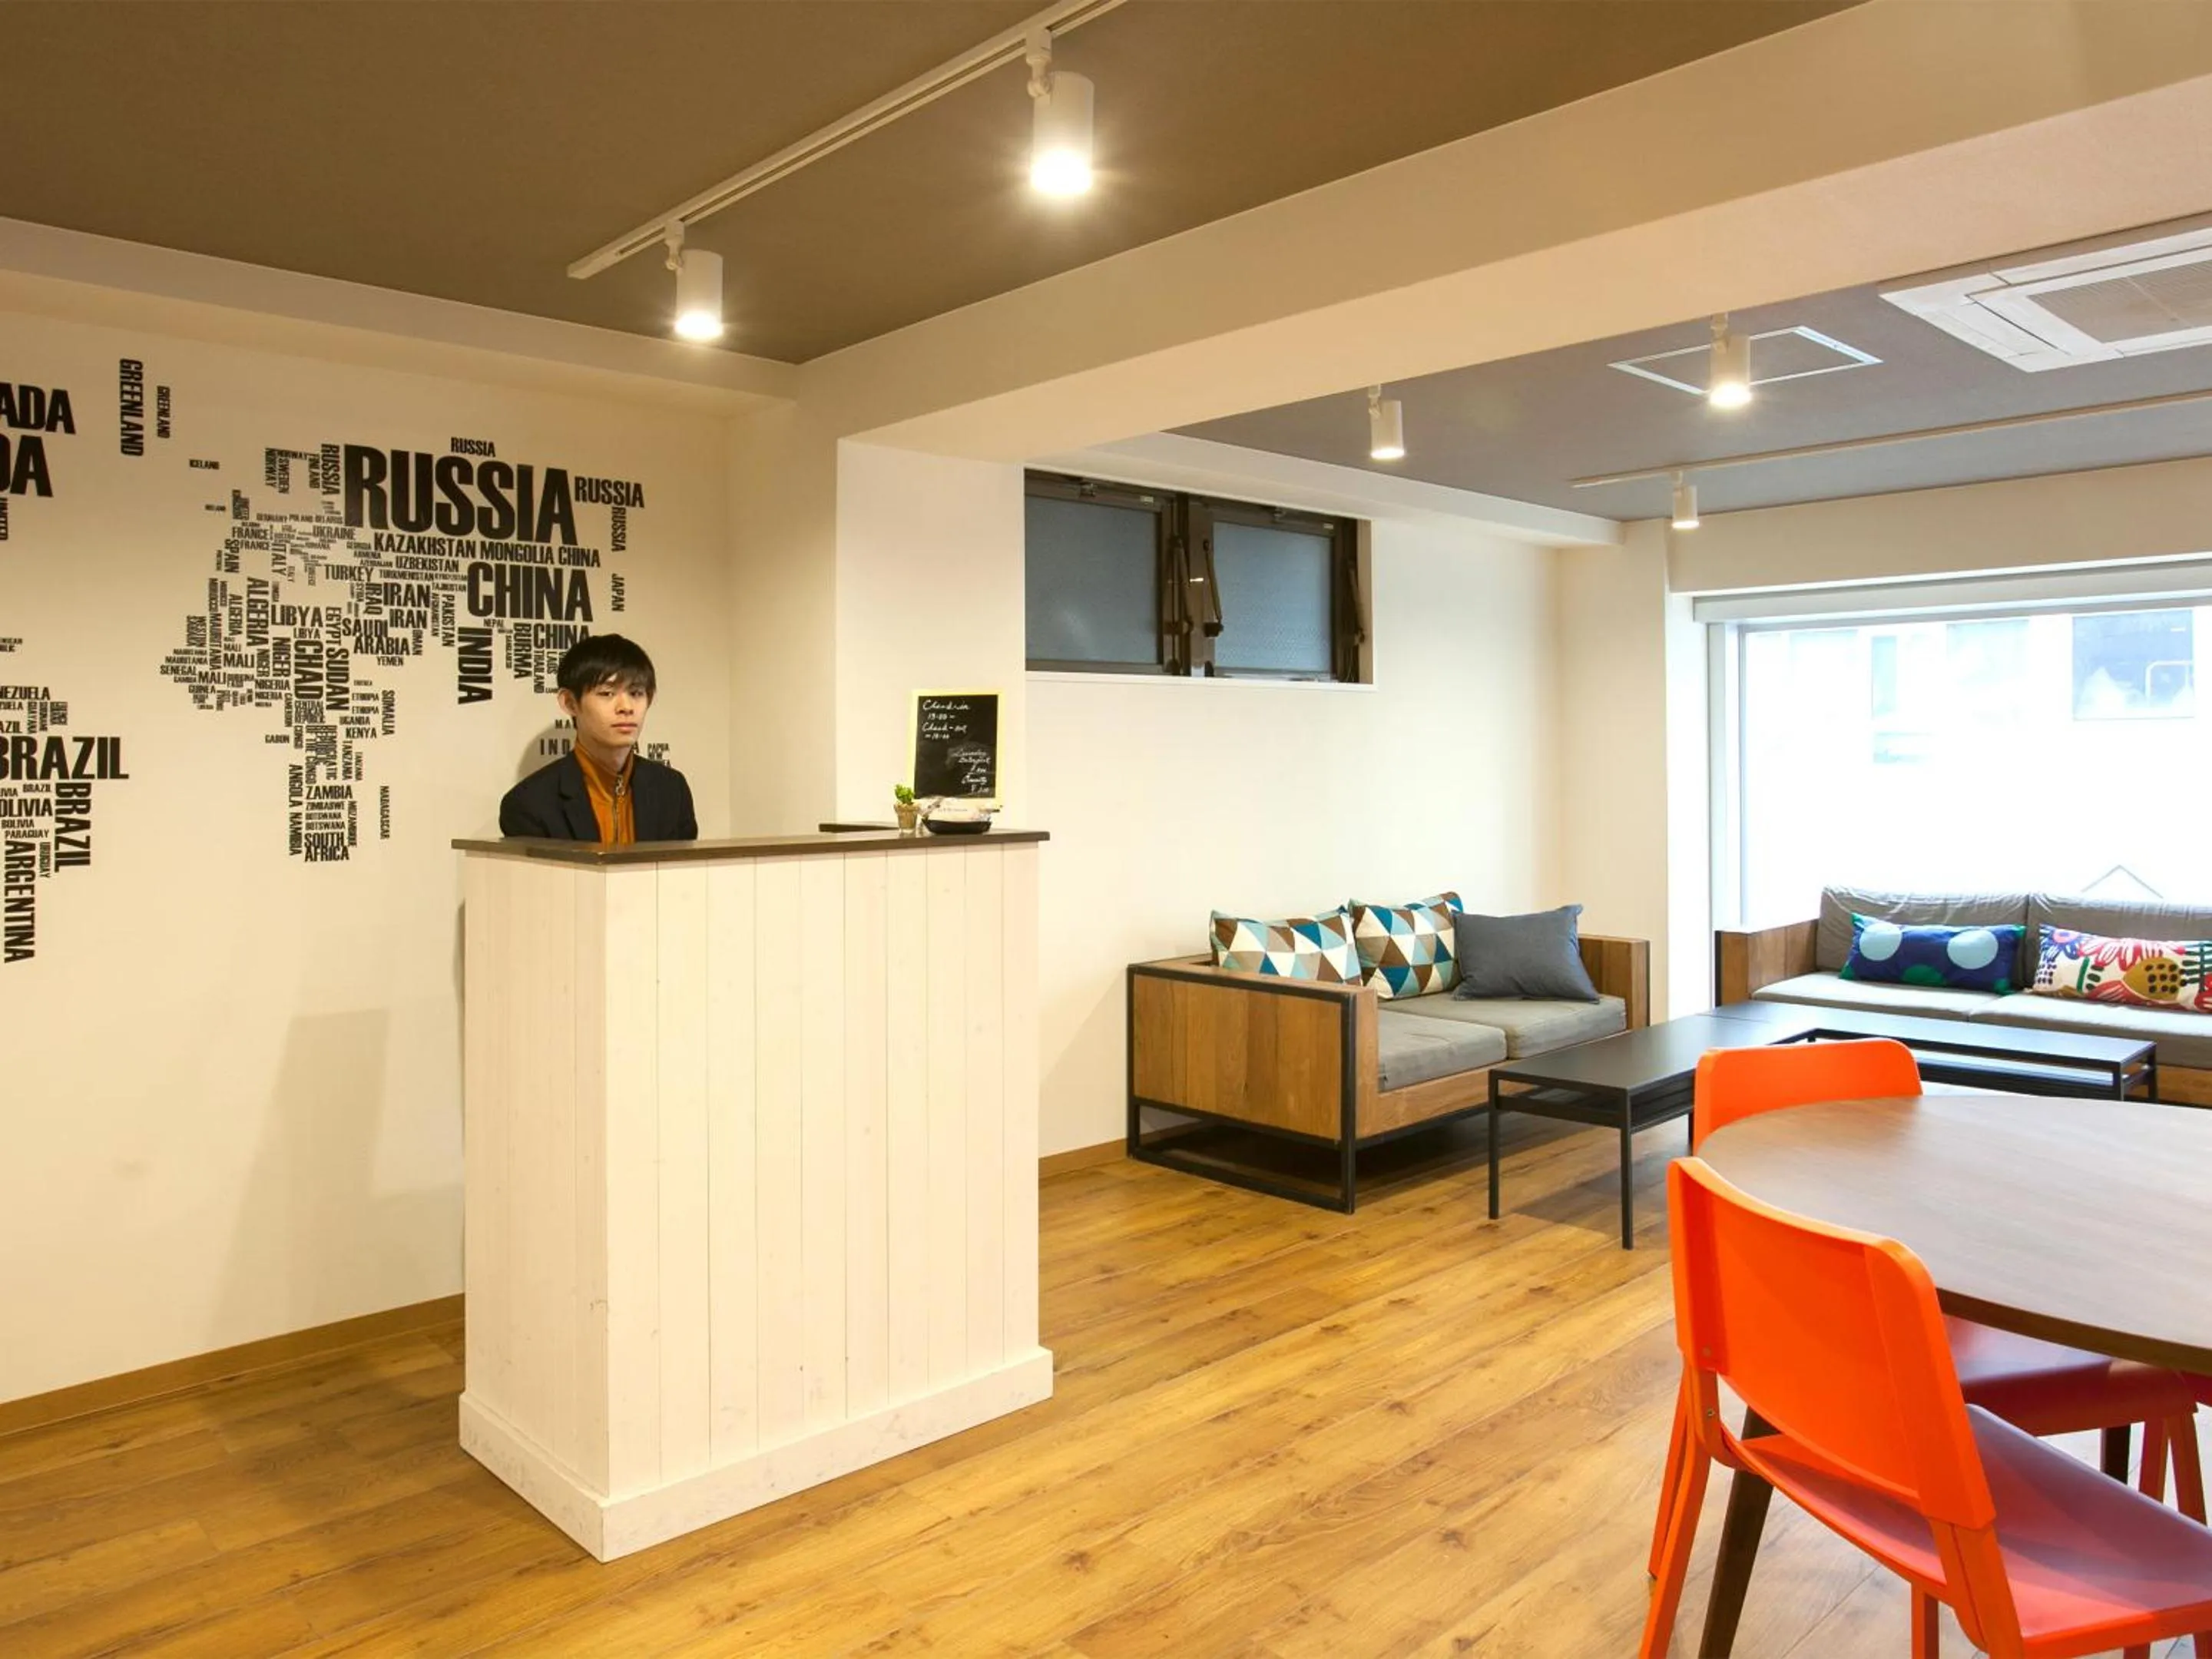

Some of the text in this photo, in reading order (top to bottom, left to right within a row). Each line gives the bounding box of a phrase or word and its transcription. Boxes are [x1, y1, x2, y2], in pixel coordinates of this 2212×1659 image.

[120, 358, 144, 456] GREENLAND
[157, 385, 171, 439] GREENLAND
[451, 437, 495, 458] RUSSIA
[321, 444, 340, 495] RUSSIA
[344, 443, 578, 546] RUSSIA
[575, 476, 644, 508] RUSSIA
[232, 526, 269, 540] FRANCE
[313, 525, 356, 540] UKRAINE
[611, 506, 627, 552] RUSSIA
[224, 539, 240, 573] SPAIN
[240, 540, 270, 551] FRANCE
[271, 543, 286, 576] ITALY
[374, 532, 601, 568] KAZAKHSTAN MONGOLIA CHINA
[324, 564, 373, 582] TURKEY
[396, 555, 459, 572] UZBEKISTAN
[363, 582, 382, 615] IRAQ
[383, 582, 431, 608] IRAN
[467, 561, 593, 622] CHINA
[611, 573, 625, 612] JAPAN
[228, 593, 243, 637] ALGERIA
[247, 577, 269, 647] ALGERIA
[271, 604, 323, 628] LIBYA
[326, 606, 342, 646] EGYPT
[389, 608, 428, 629] IRAN
[442, 593, 455, 647] PAKISTAN
[293, 628, 321, 640] LIBYA
[342, 617, 389, 637] SAUDI
[209, 612, 222, 671] MAURITANIA
[224, 643, 241, 652] MALI
[353, 635, 411, 655] ARABIA
[412, 629, 423, 656] OMAN
[513, 622, 533, 679] BURMA
[160, 664, 197, 676] SENEGAL
[223, 653, 254, 668] MALI
[256, 648, 270, 677] NIGER
[272, 637, 291, 677] NIGER
[293, 639, 324, 700] CHAD
[376, 656, 404, 667] YEMEN
[458, 626, 493, 705] INDIA
[198, 671, 227, 684] MALI
[255, 678, 290, 690] NIGERIA
[326, 647, 350, 710] SUDAN
[534, 650, 545, 694] THAILAND
[339, 715, 371, 726] UGANDA
[381, 689, 396, 736] SOMALIA
[346, 726, 378, 739] KENYA
[22, 783, 51, 793] BRAZIL
[306, 785, 353, 800] ZAMBIA
[289, 763, 303, 856] ANGOLA NAMIBIA
[1, 818, 35, 830] BOLIVIA
[5, 829, 49, 839] PARAGUAY
[55, 782, 91, 873] BRAZIL
[305, 821, 346, 831] BOTSWANA
[304, 832, 345, 847] SOUTH
[304, 846, 349, 862] AFRICA
[4, 840, 36, 964] ARGENTINA
